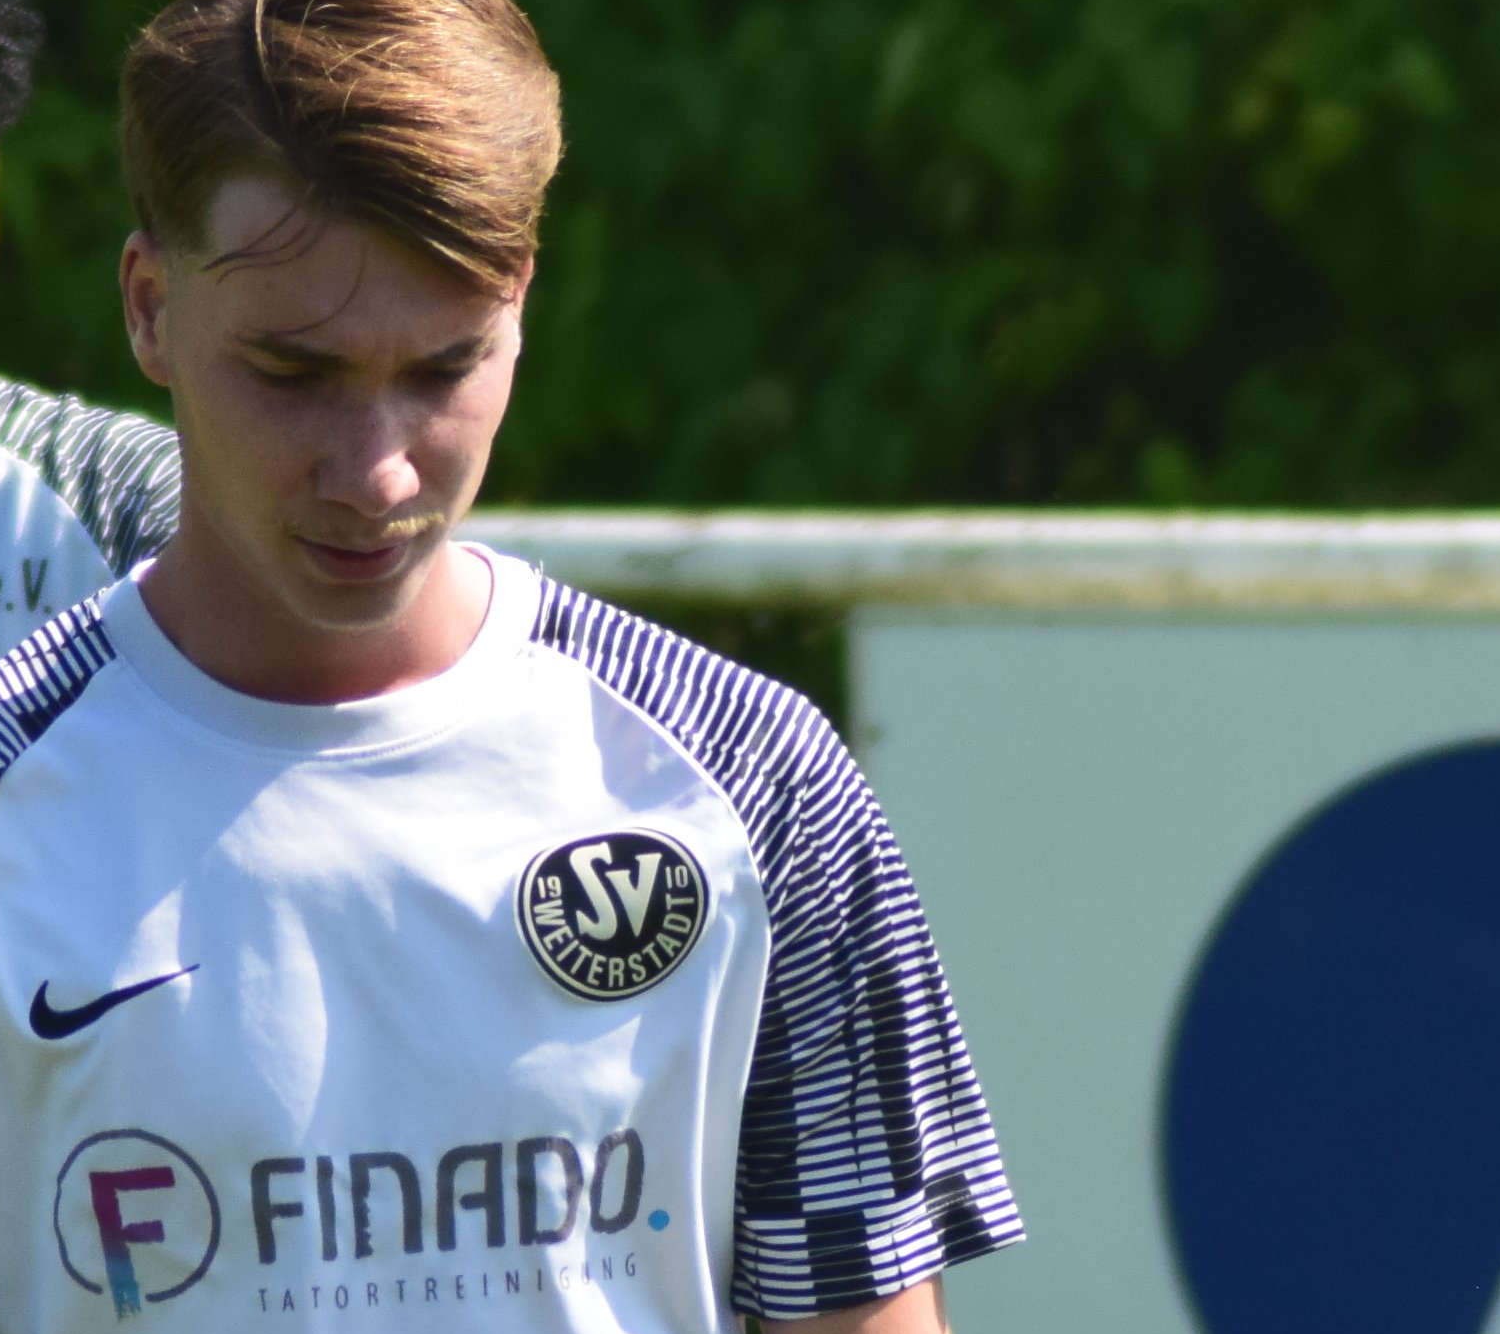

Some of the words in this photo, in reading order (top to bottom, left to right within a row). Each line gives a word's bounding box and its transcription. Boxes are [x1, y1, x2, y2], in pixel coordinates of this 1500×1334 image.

[570, 841, 662, 941] SV
[534, 893, 695, 988] WEITERSTADT
[259, 1253, 637, 1312] TATORTREINIGUNG
